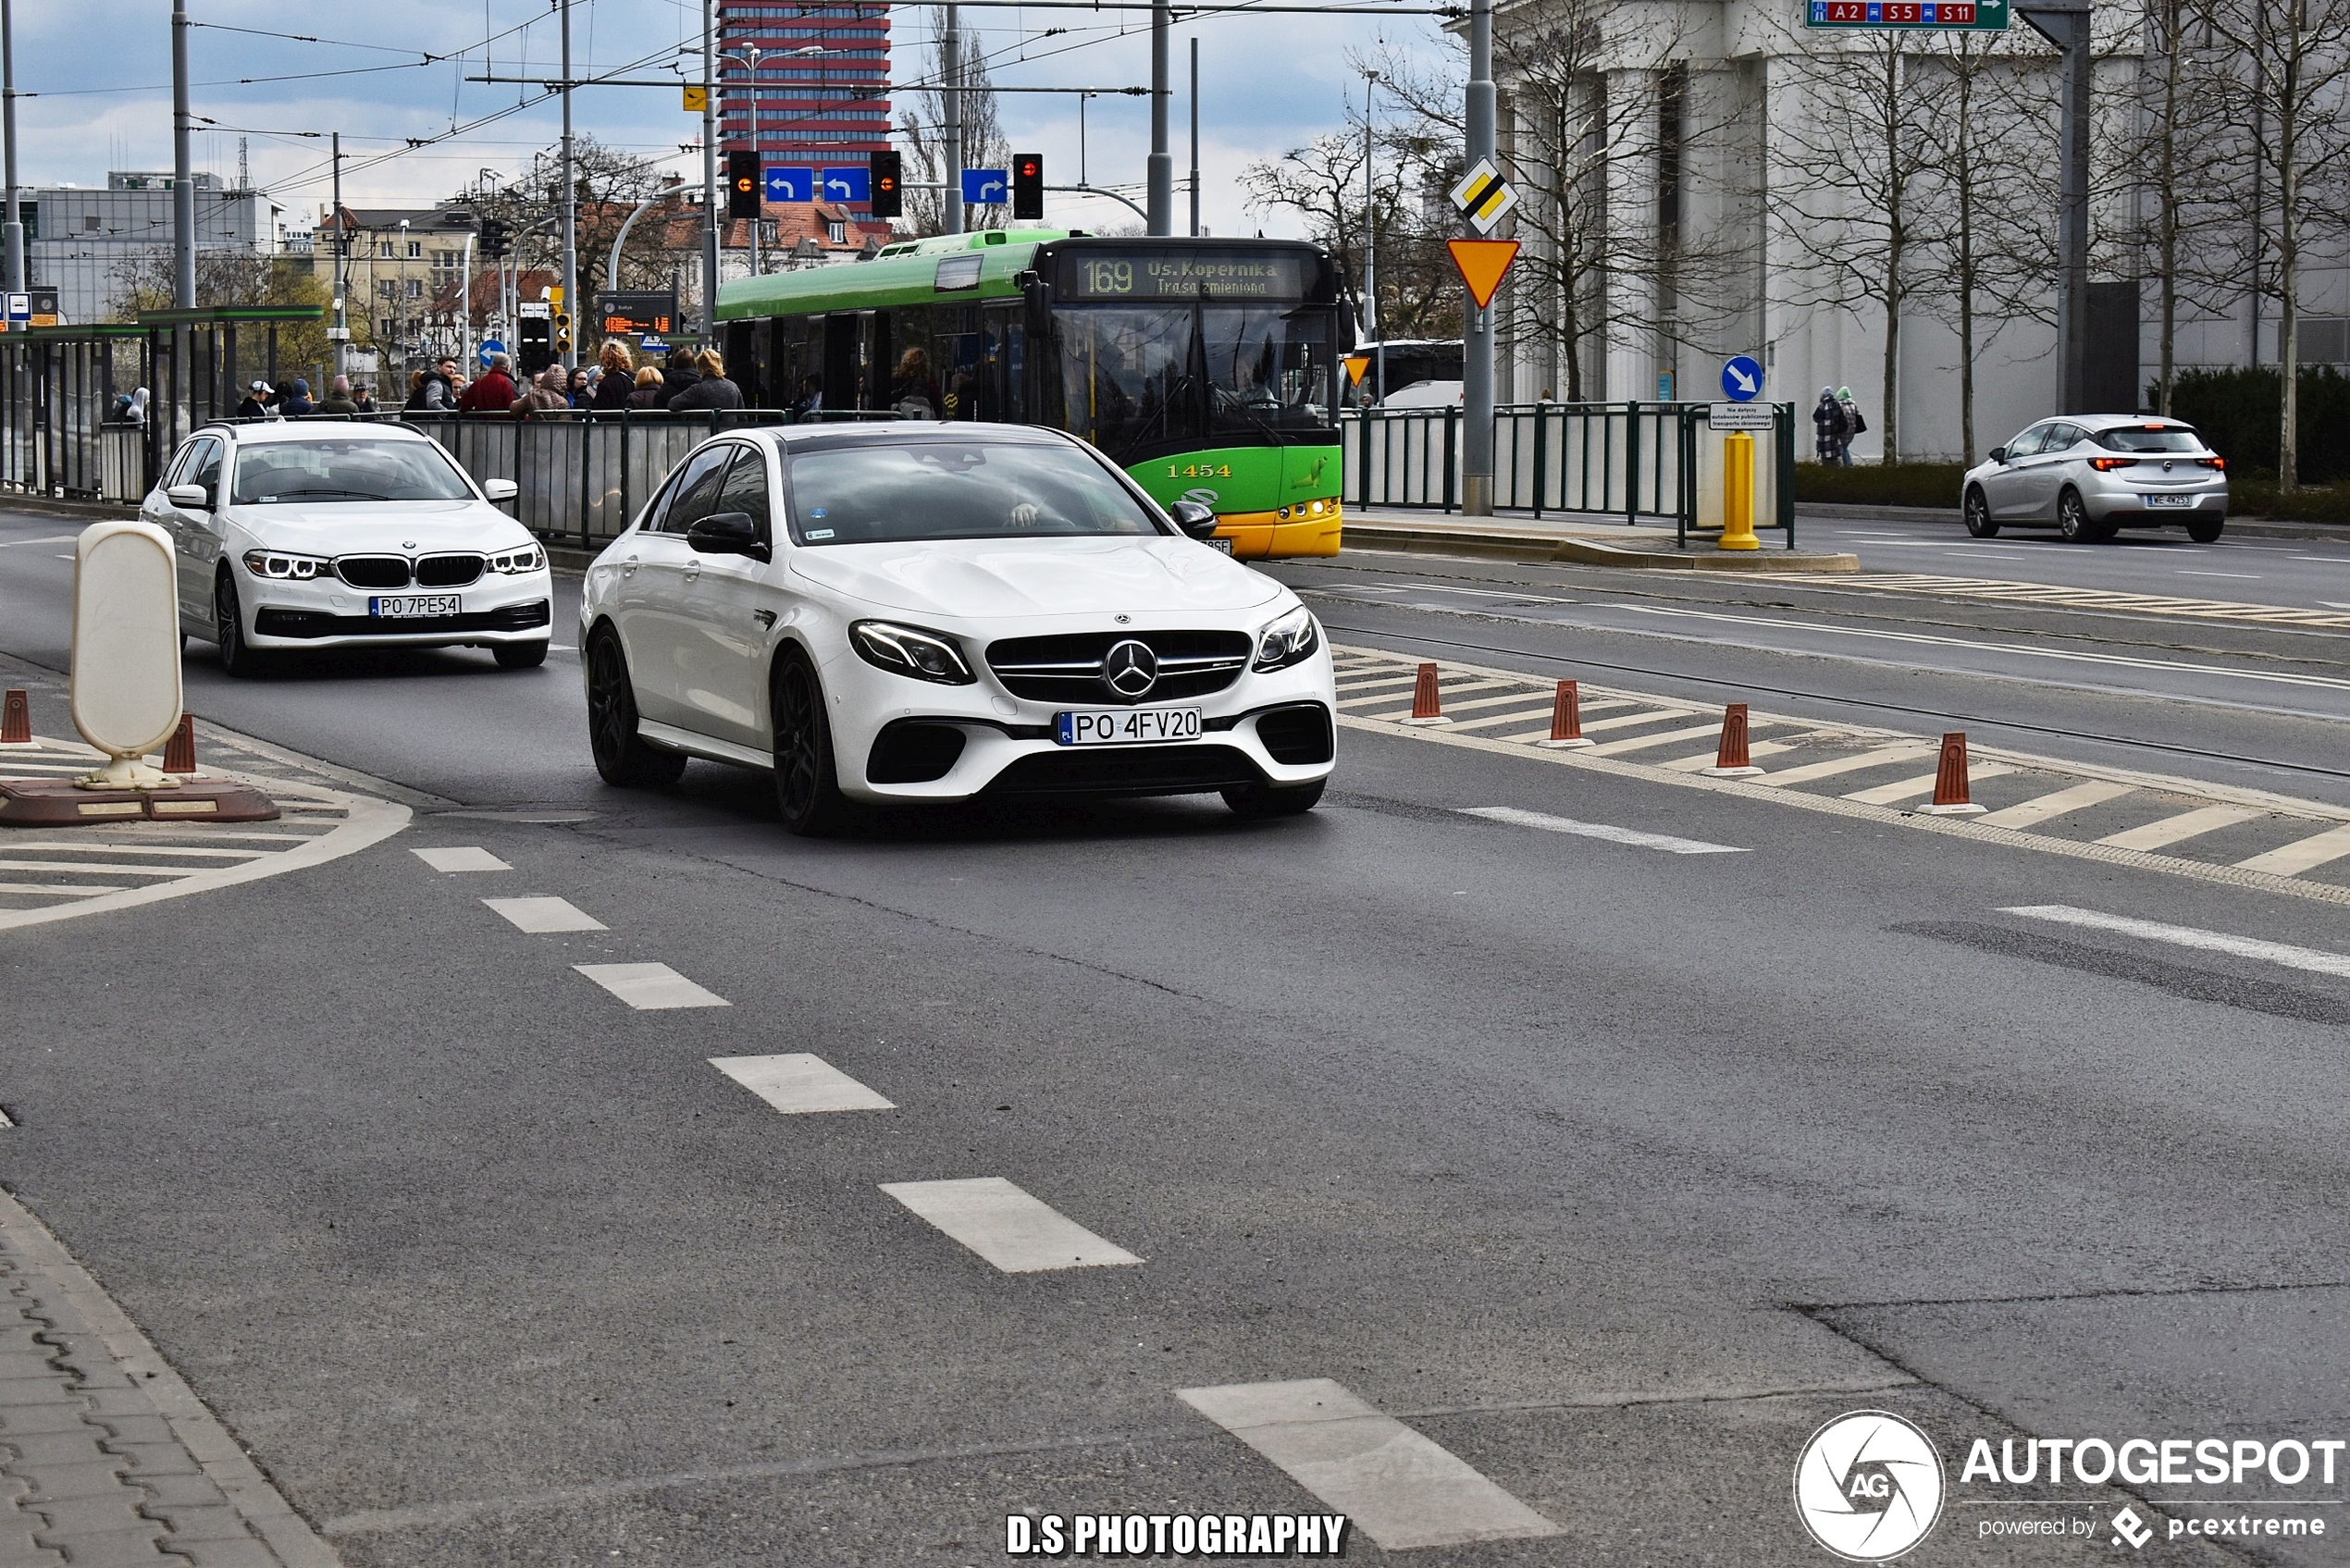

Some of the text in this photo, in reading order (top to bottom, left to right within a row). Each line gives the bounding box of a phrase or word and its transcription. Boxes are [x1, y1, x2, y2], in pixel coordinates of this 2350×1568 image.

[1835, 5, 1858, 19] A 2
[1889, 6, 1913, 19] S 5
[1944, 6, 1969, 20] S 11
[1083, 260, 1133, 293] 169
[1181, 262, 1278, 278] Kopernika
[1157, 278, 1267, 294] Trasa zmieniona
[1167, 464, 1232, 478] 1454
[2154, 496, 2164, 504] WE
[2166, 496, 2190, 504] 4W253
[381, 597, 456, 614] PO 7PE54
[1076, 710, 1197, 741] PO 4FV20
[1061, 731, 1071, 739] PL
